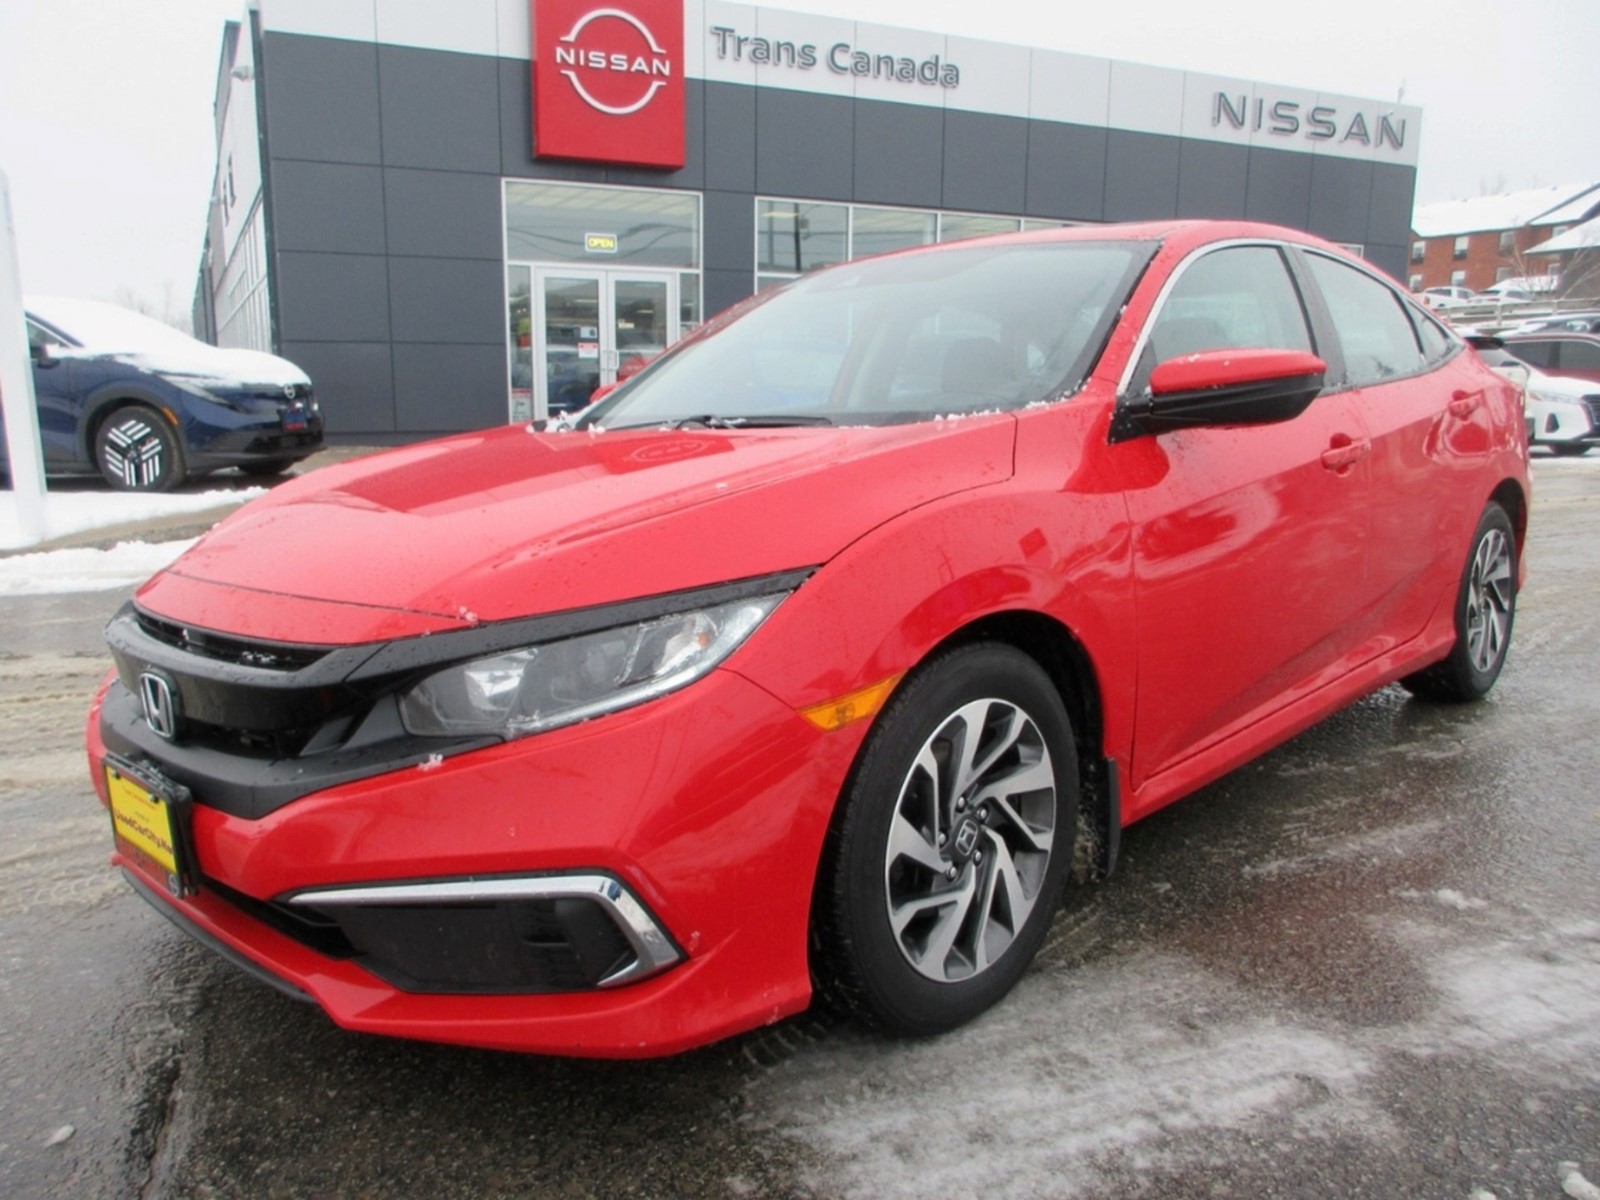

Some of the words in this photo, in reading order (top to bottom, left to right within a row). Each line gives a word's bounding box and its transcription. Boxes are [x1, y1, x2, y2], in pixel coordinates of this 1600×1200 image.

[555, 45, 671, 77] NISSAN
[710, 26, 817, 68] Trans
[827, 42, 961, 88] Canada
[1212, 91, 1406, 151] NISSAN
[588, 237, 614, 248] OPEN
